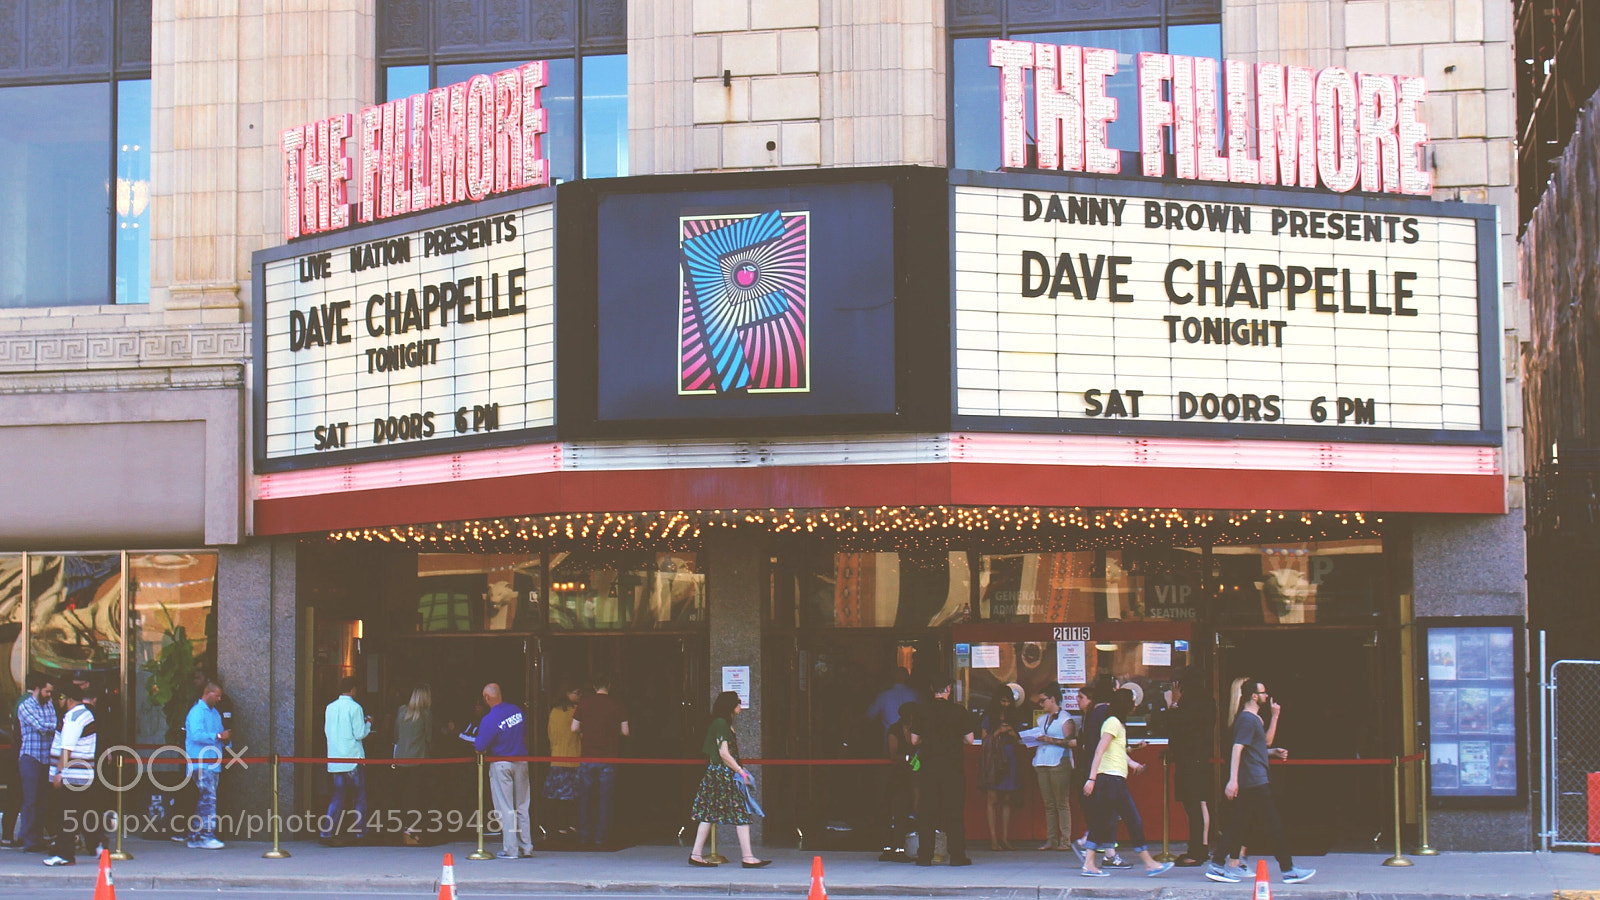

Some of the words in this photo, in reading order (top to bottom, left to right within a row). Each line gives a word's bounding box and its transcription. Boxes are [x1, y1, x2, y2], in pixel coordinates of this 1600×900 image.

[988, 39, 1121, 173] THE
[1136, 52, 1433, 195] FILLMORE
[278, 113, 352, 239] THE
[357, 60, 549, 223] FILLMORE
[1023, 193, 1127, 227] DANNY
[1144, 201, 1252, 235] BROWN
[1271, 209, 1420, 244] PRESENTS
[299, 253, 332, 282] LIVE
[350, 237, 410, 273] NATION
[423, 214, 517, 258] PRESENTS
[1021, 250, 1134, 303] DAVE
[1164, 258, 1418, 317] CHAPPELLE
[290, 300, 351, 352] DAVE
[365, 267, 526, 337] CHAPPELLE
[1163, 315, 1287, 348] TONIGHT
[366, 338, 440, 374] TONIGHT
[1084, 389, 1144, 418] SAT
[1179, 391, 1281, 422] DOORS
[314, 422, 349, 450] SAT
[373, 411, 435, 443] DOORS
[994, 591, 1041, 601] GENERAL
[1150, 607, 1196, 619] SEATING
[1154, 585, 1192, 604] VIP
[1054, 627, 1090, 640] 2115
